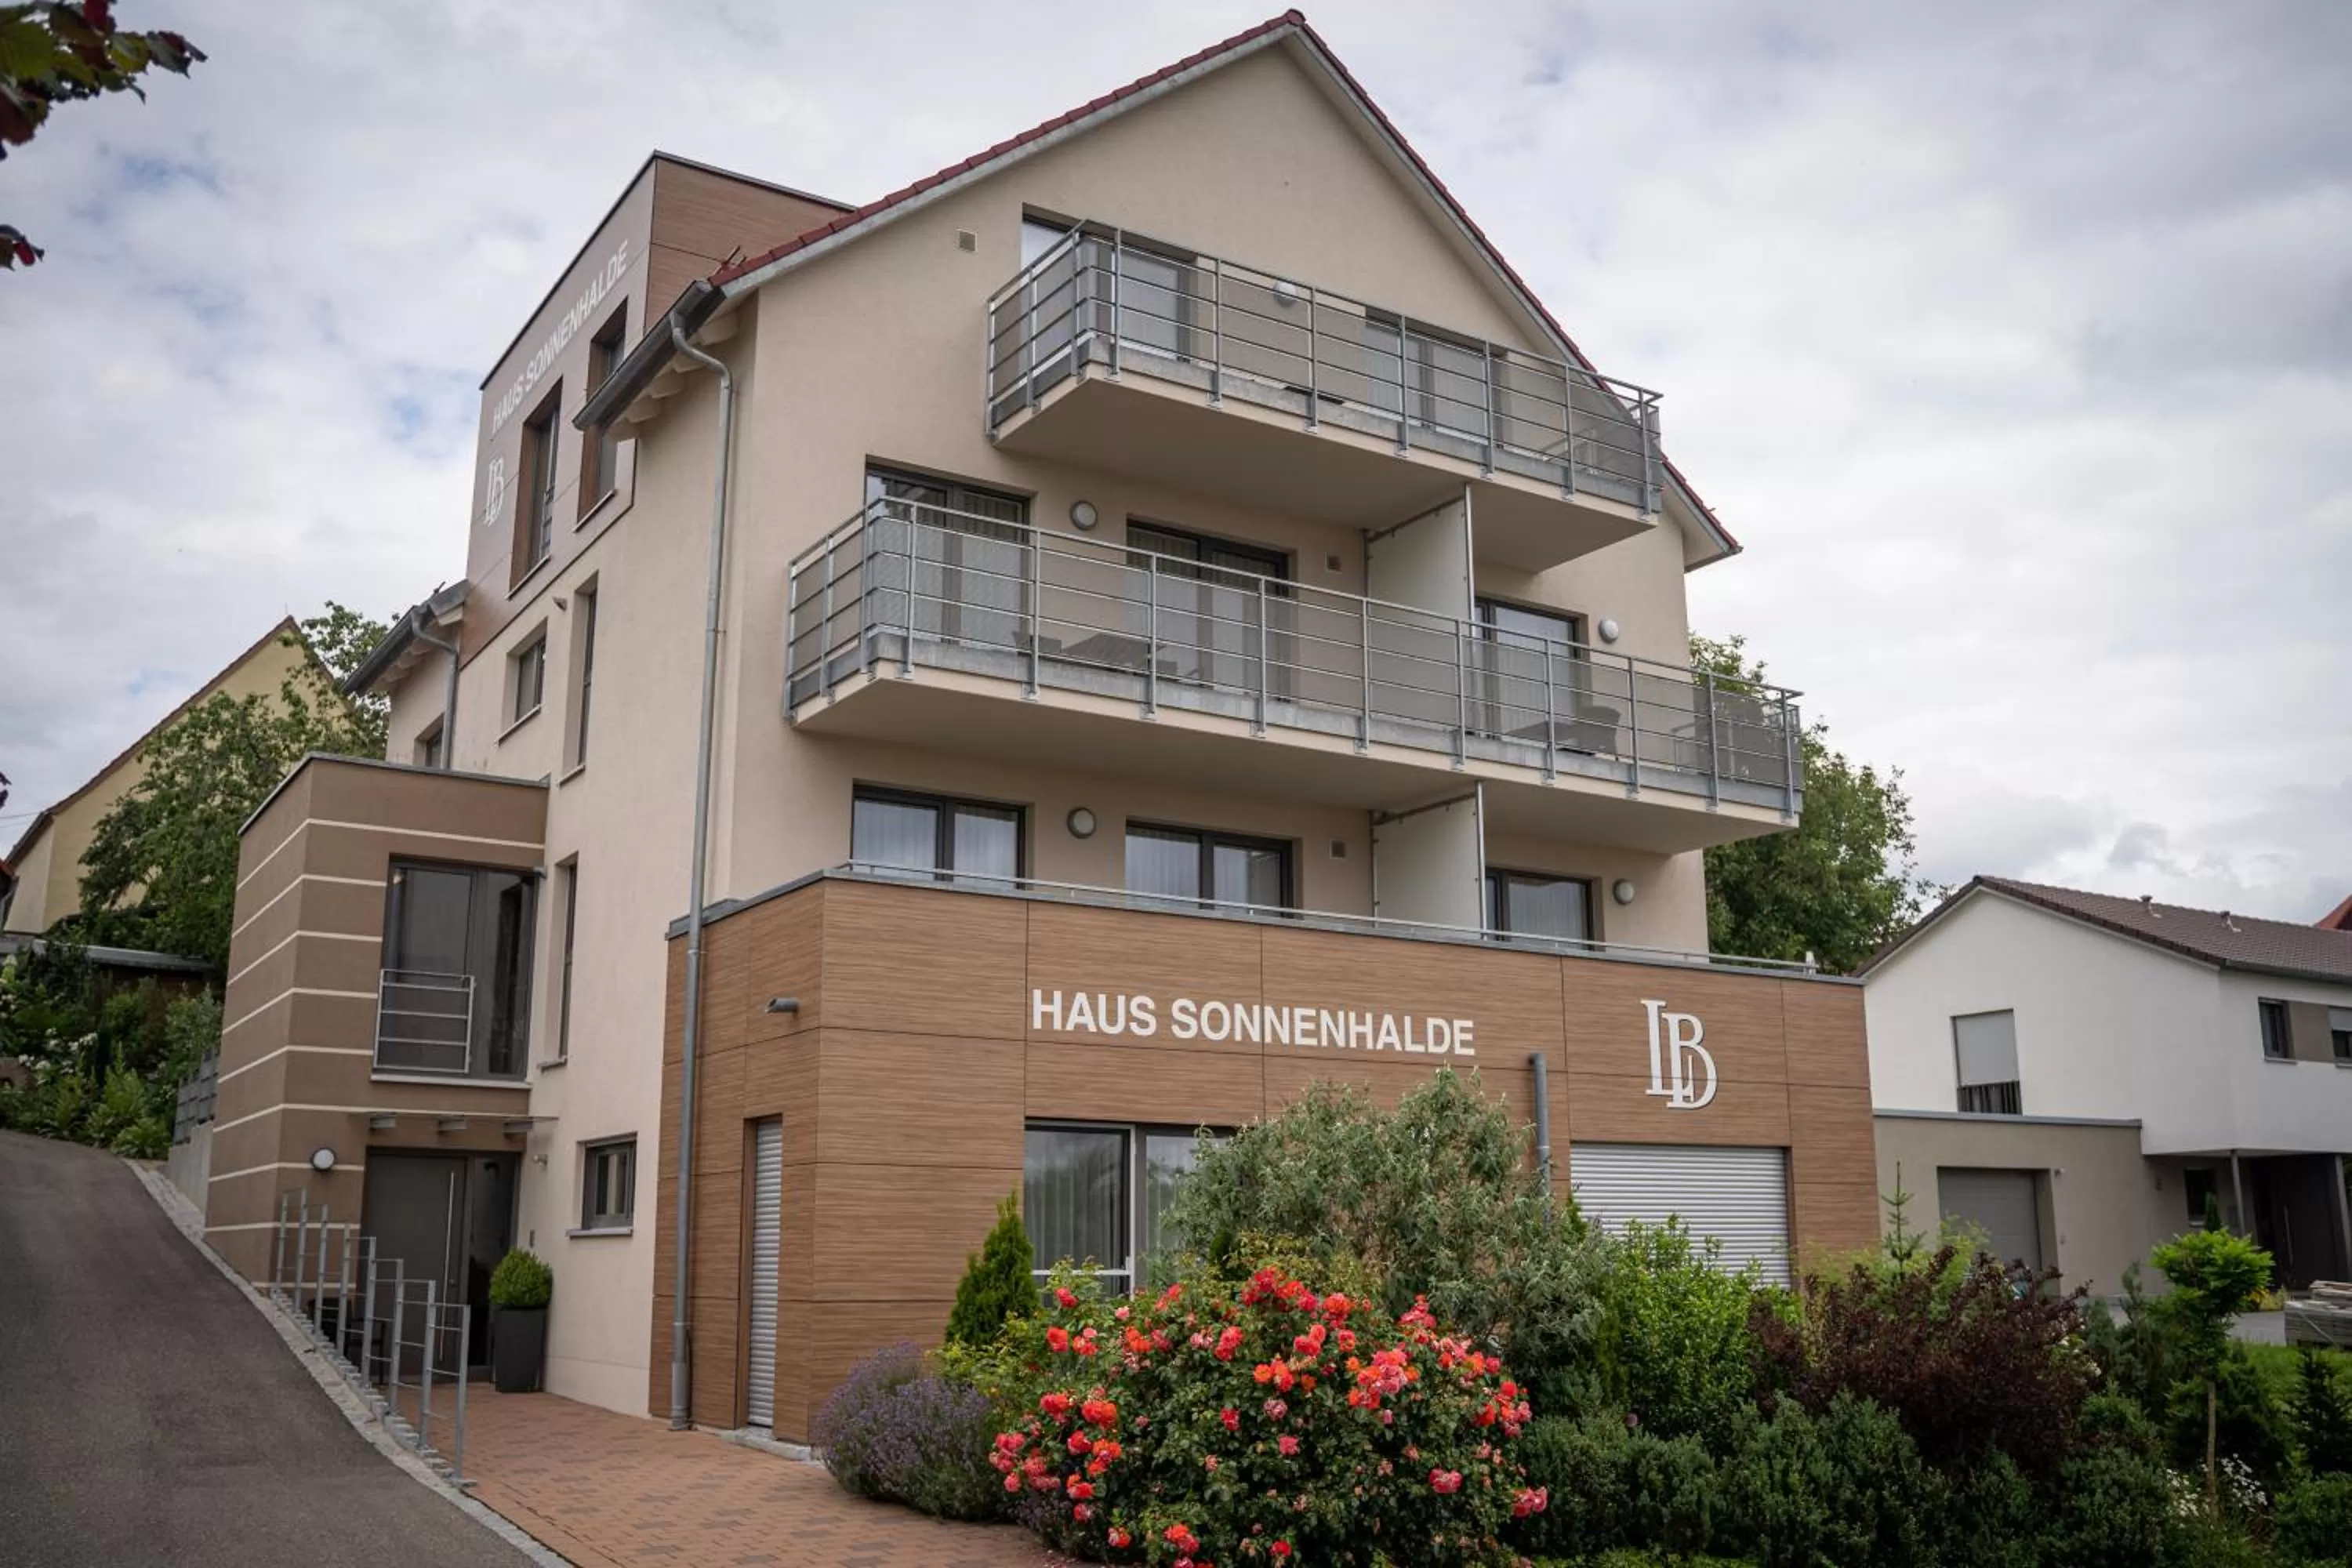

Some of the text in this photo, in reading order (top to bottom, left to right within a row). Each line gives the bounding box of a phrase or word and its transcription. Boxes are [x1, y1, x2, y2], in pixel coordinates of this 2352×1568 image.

[492, 239, 627, 434] HAUS SONNENHALDE
[1032, 989, 1475, 1056] HAUS SONNENHALDE
